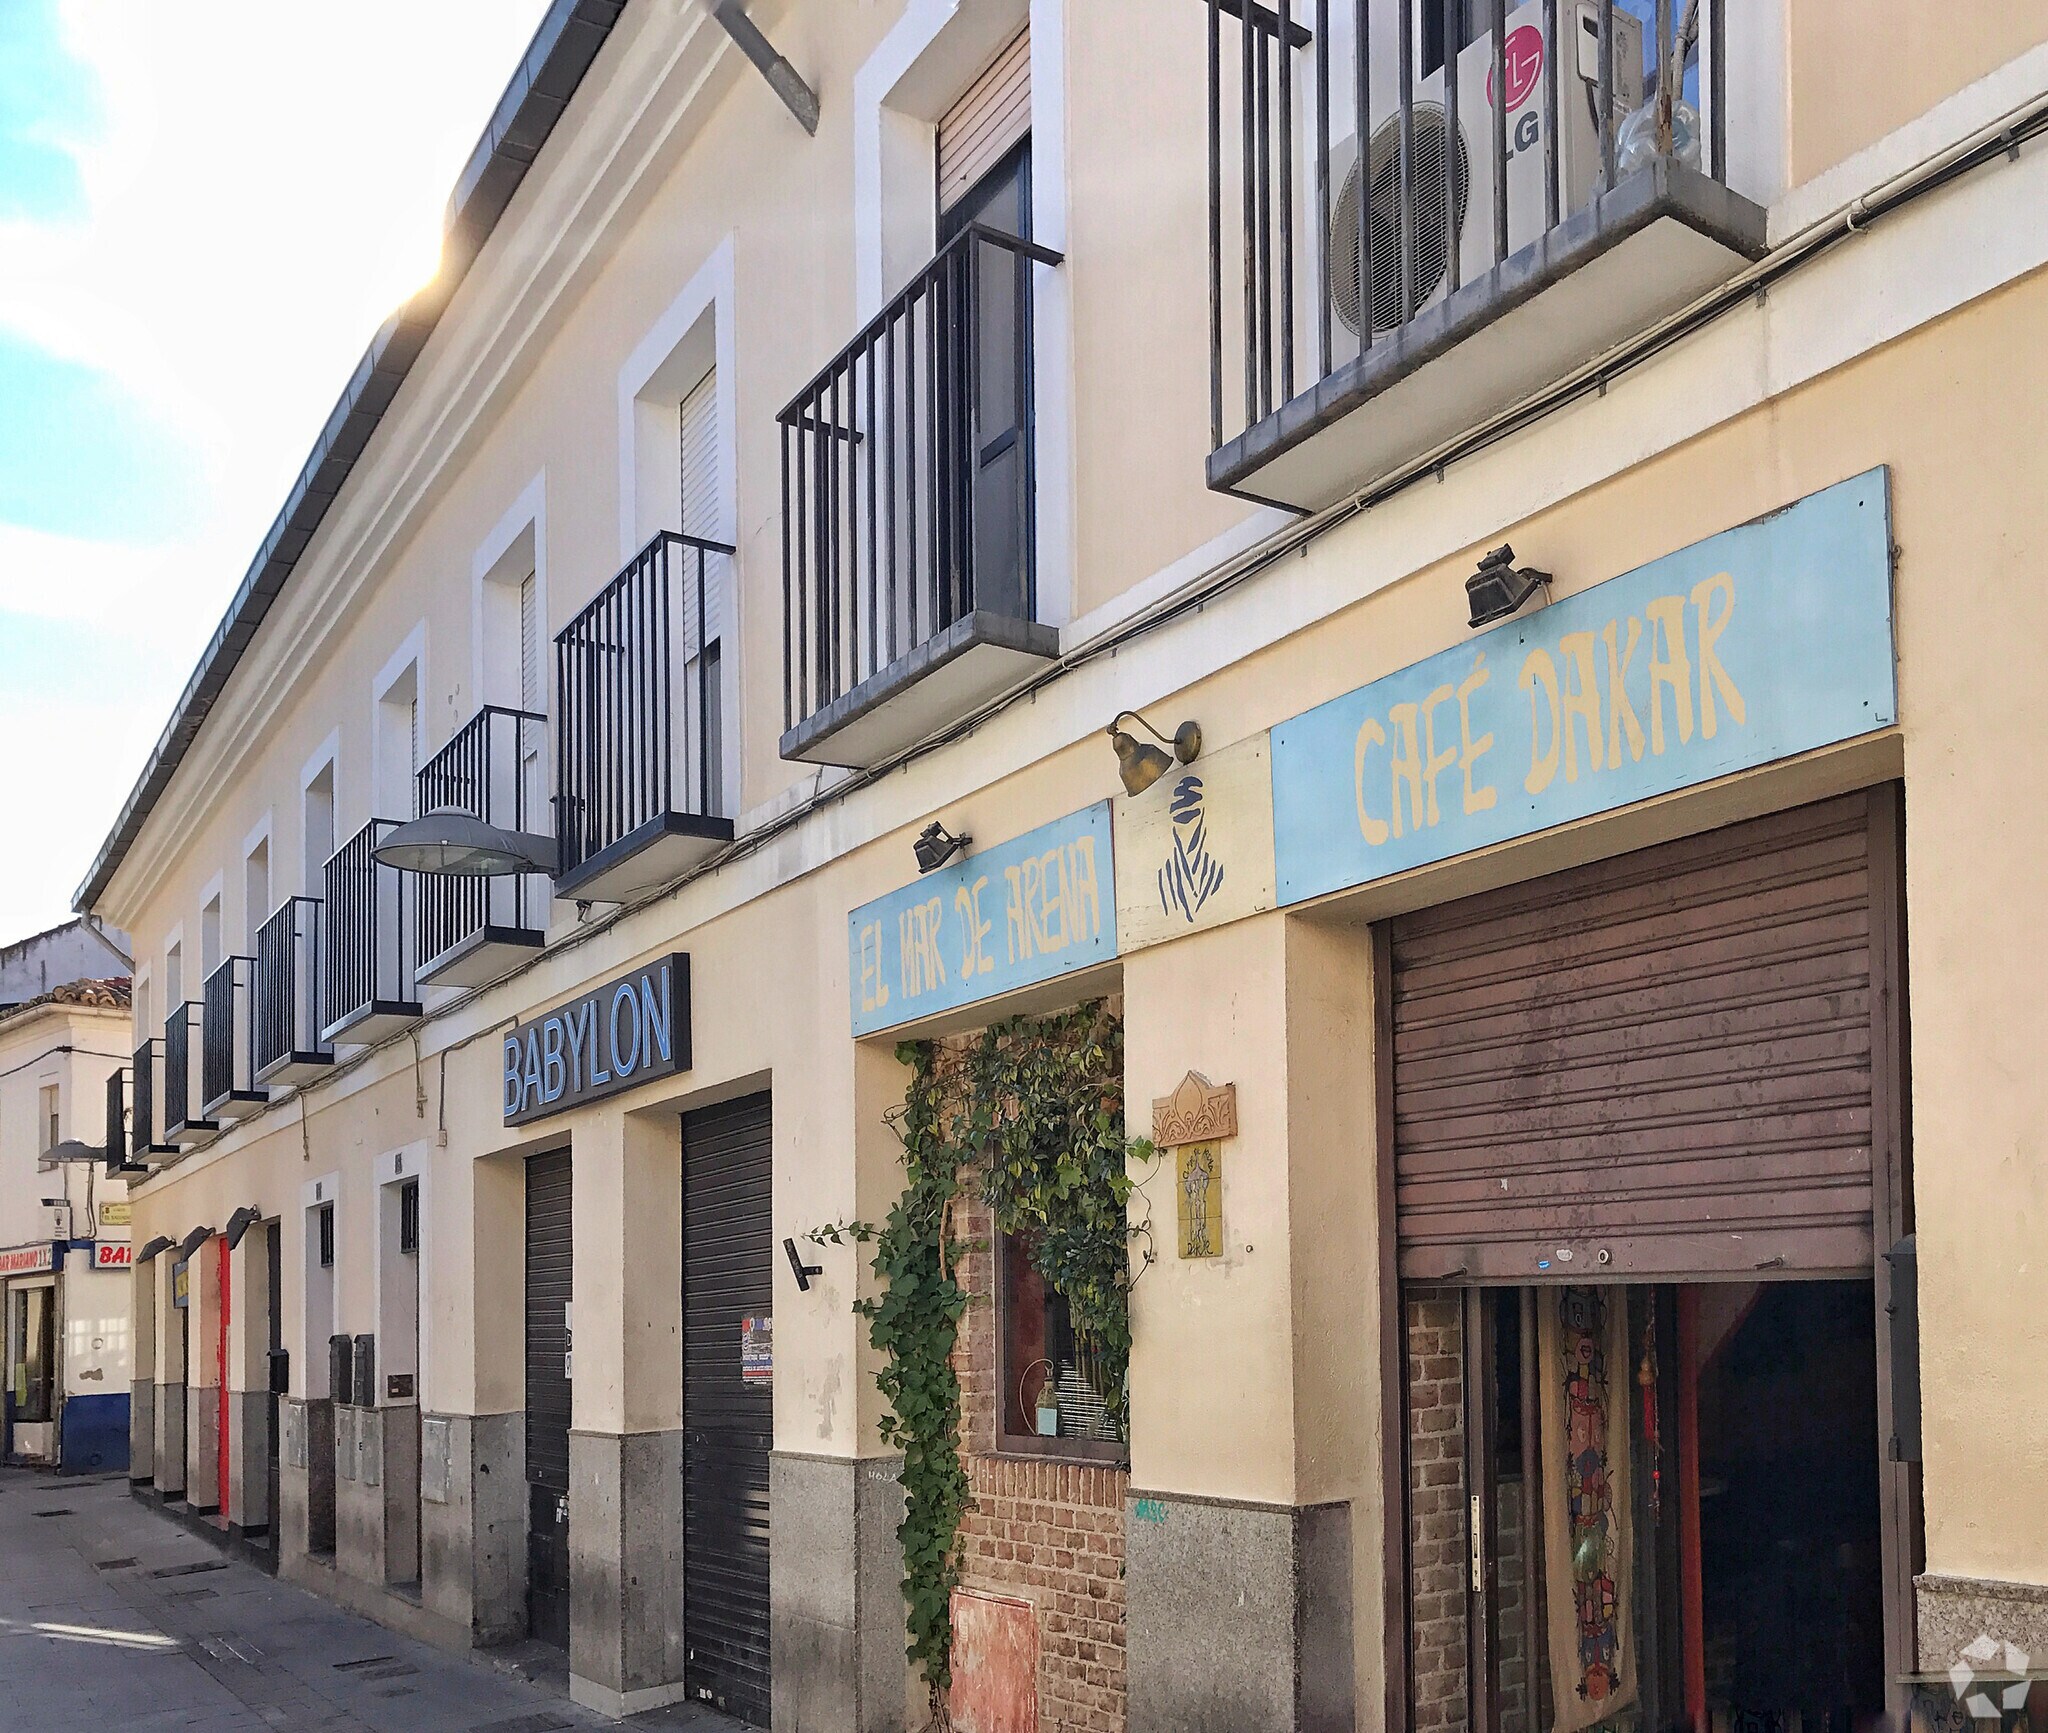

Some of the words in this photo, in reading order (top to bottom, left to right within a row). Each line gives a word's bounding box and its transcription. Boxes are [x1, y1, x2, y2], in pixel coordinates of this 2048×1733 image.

[1355, 652, 1497, 845] CAFÉ
[1519, 572, 1746, 794] DAKAR
[860, 920, 889, 1012] EL
[899, 896, 946, 999] MAR
[955, 875, 994, 980] DE
[1004, 836, 1099, 965] ARENA
[504, 966, 672, 1118] BABYLON
